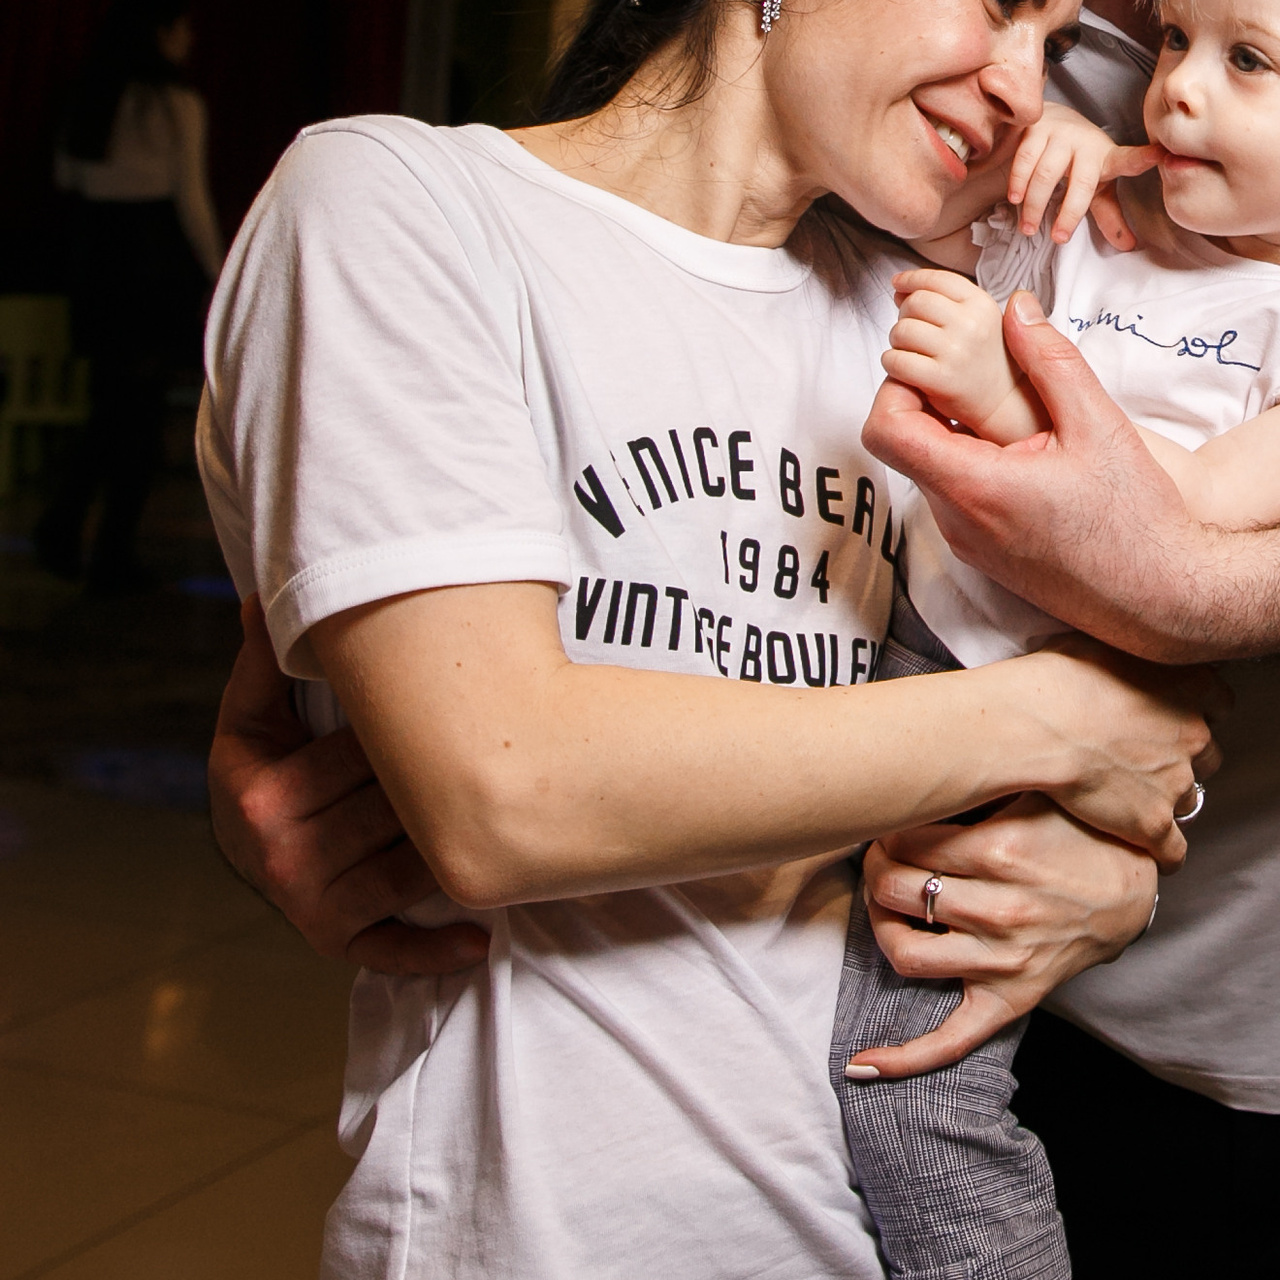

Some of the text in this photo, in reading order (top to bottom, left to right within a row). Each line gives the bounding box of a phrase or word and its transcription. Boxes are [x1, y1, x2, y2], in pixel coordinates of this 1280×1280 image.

[1176, 330, 1261, 371] sol
[573, 427, 756, 538] VNICE
[720, 531, 830, 603] 1984
